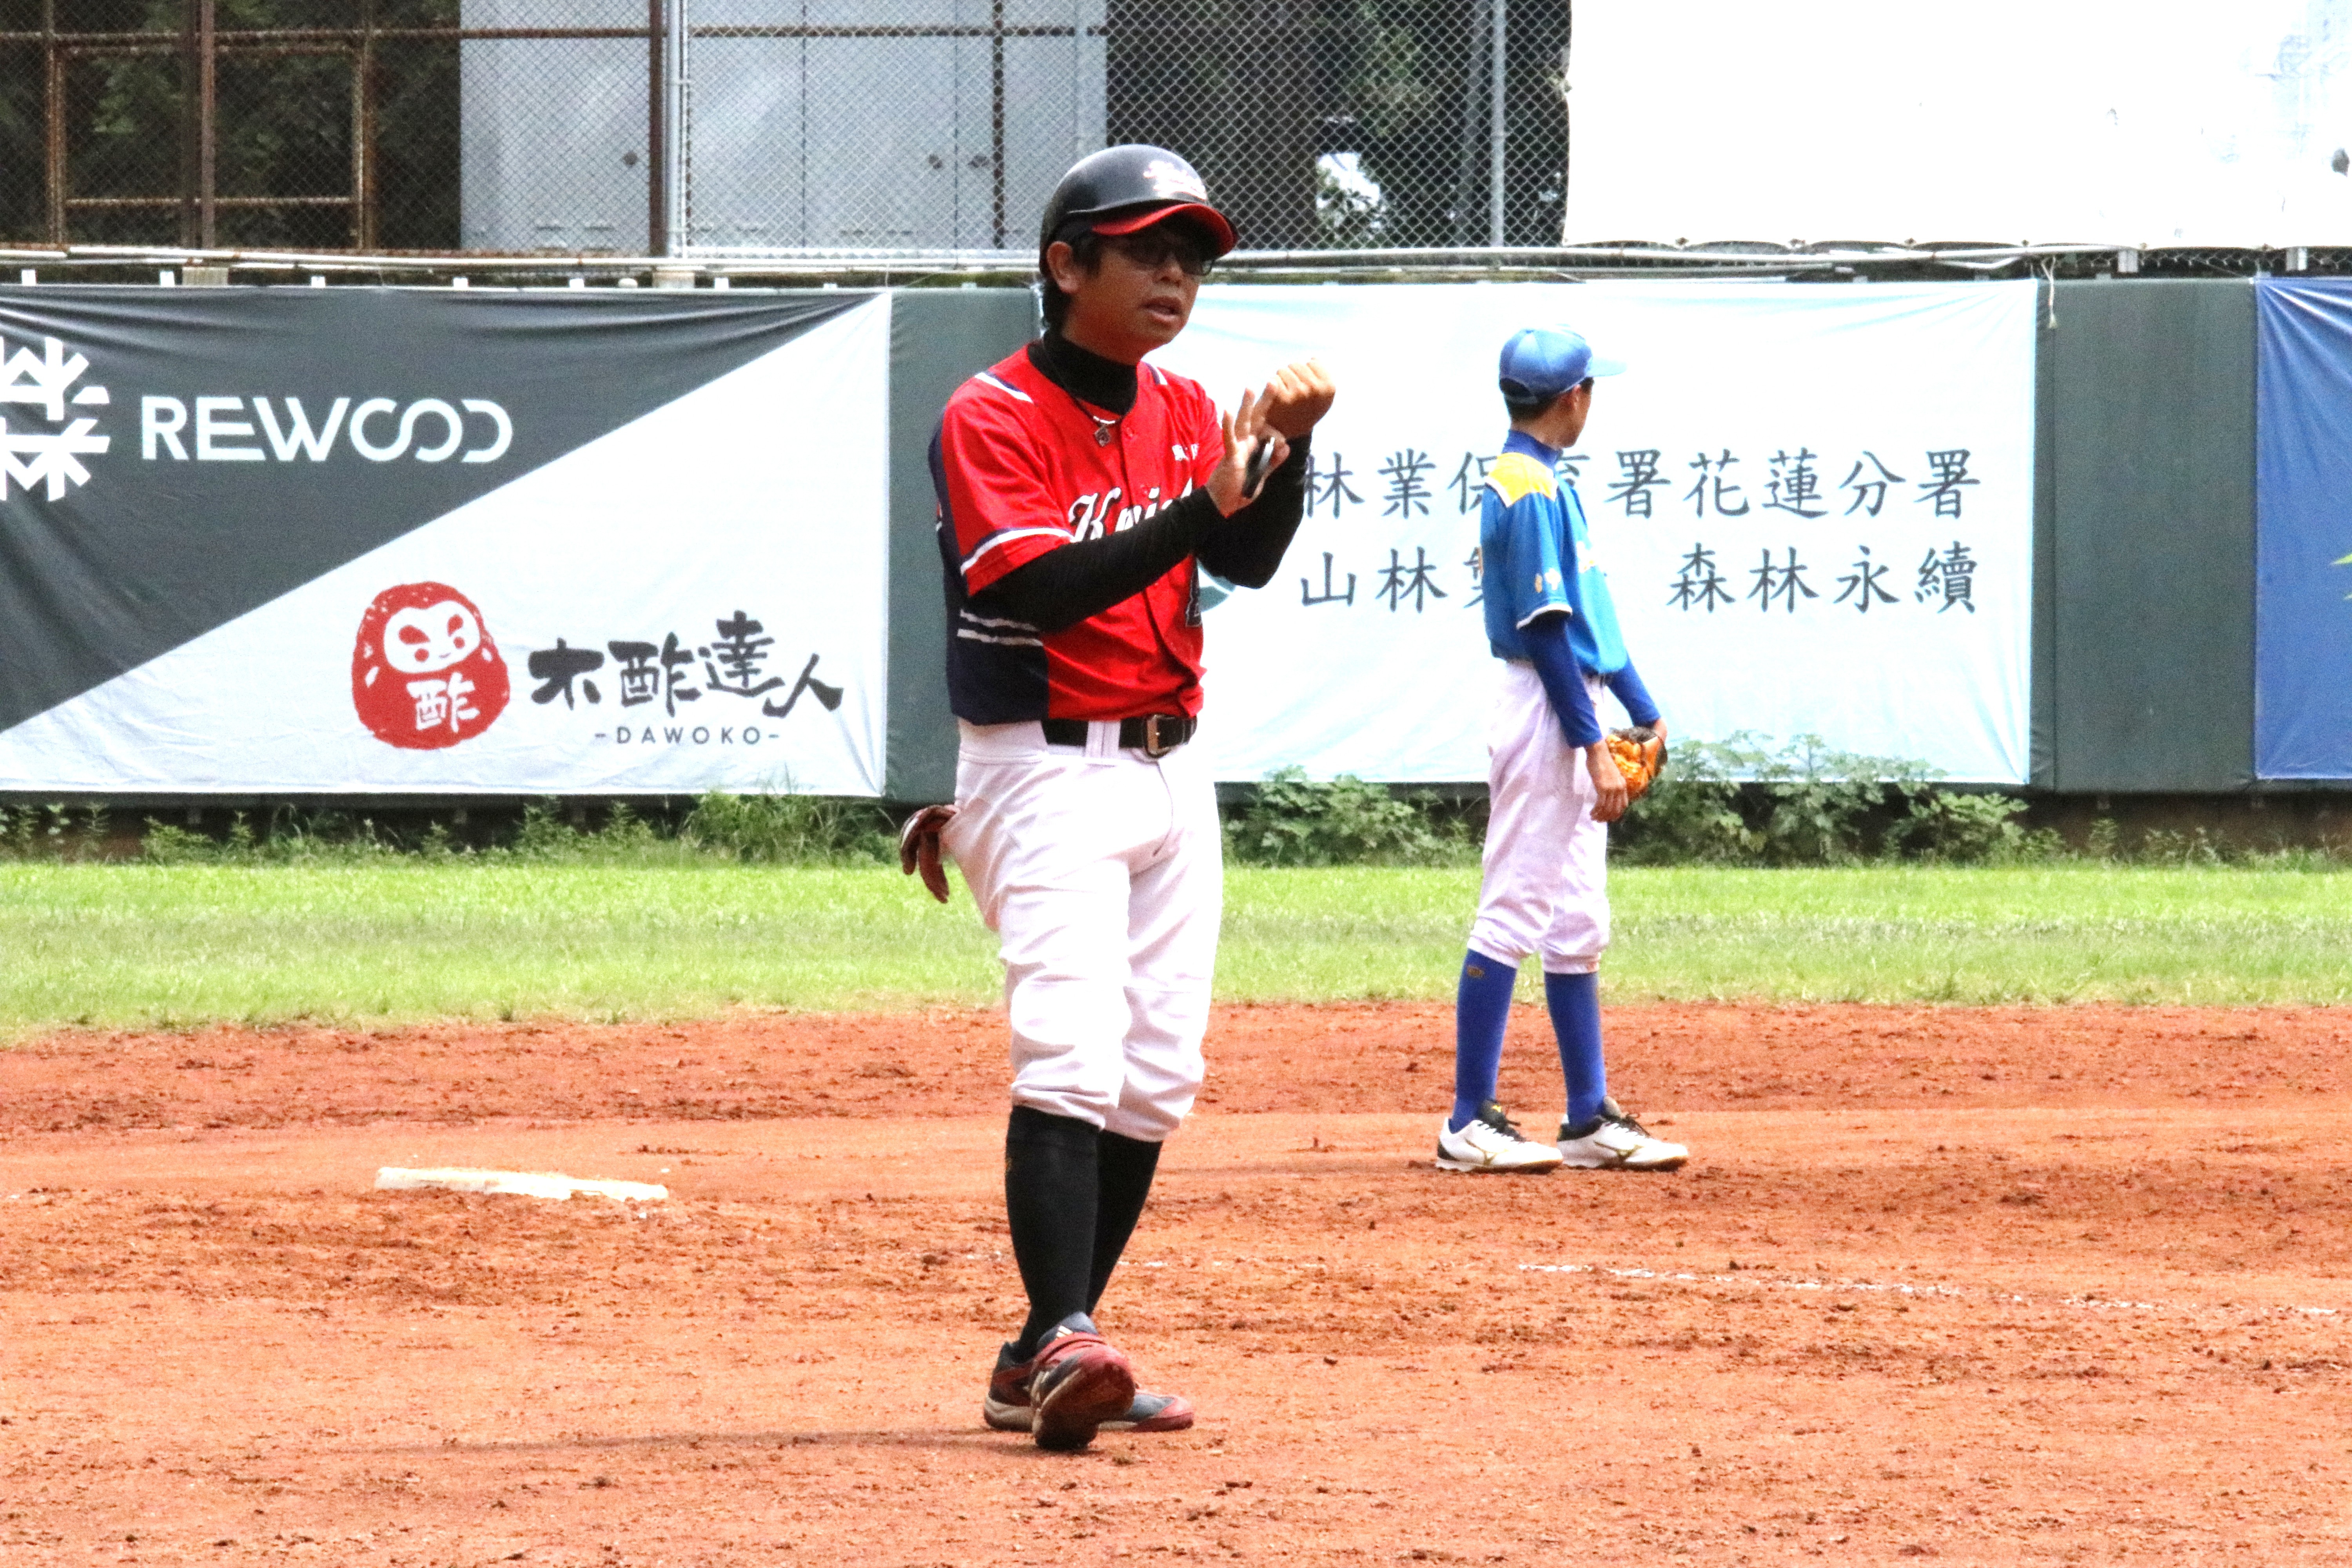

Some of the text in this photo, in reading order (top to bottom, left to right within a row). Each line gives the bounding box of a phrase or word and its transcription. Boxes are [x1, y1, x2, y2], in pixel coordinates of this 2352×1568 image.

[141, 395, 514, 464] REWOOD
[1666, 541, 1978, 613] 森林永續
[528, 610, 844, 718] 木酢達人
[406, 671, 481, 733] 酢
